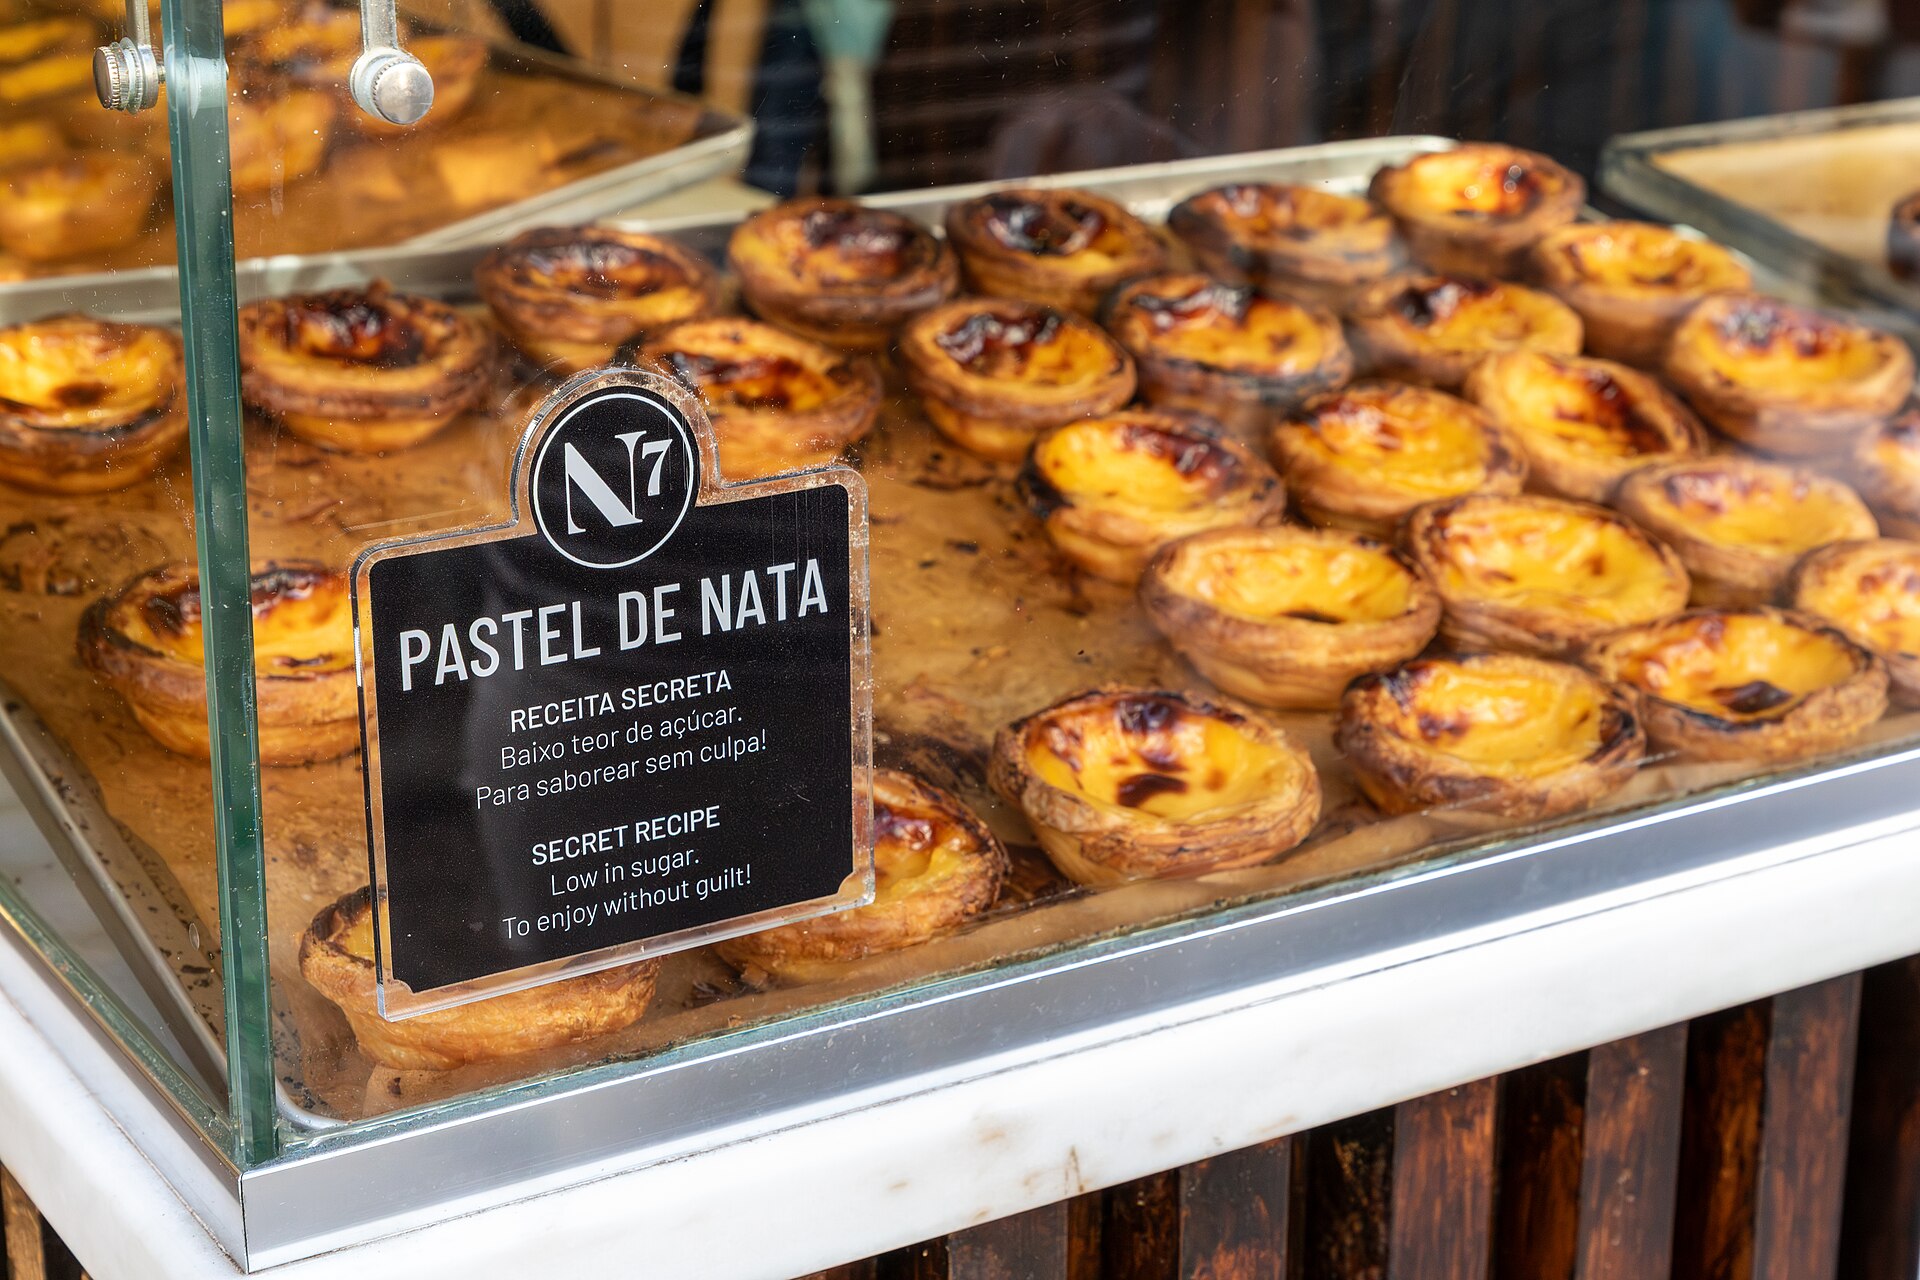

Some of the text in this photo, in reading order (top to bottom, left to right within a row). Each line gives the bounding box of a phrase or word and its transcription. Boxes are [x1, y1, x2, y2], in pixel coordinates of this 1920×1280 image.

[399, 558, 829, 692] PASTEL DE NATA
[510, 669, 732, 733] RECEITA SECRETA
[476, 728, 767, 810] Para saborear sem culpa!
[501, 705, 743, 770] Baixo teor de açúcar.
[531, 804, 721, 866] SECRET RECIPE
[502, 864, 752, 939] To enjoy without guilt!
[551, 848, 700, 896] Low in sugar.
